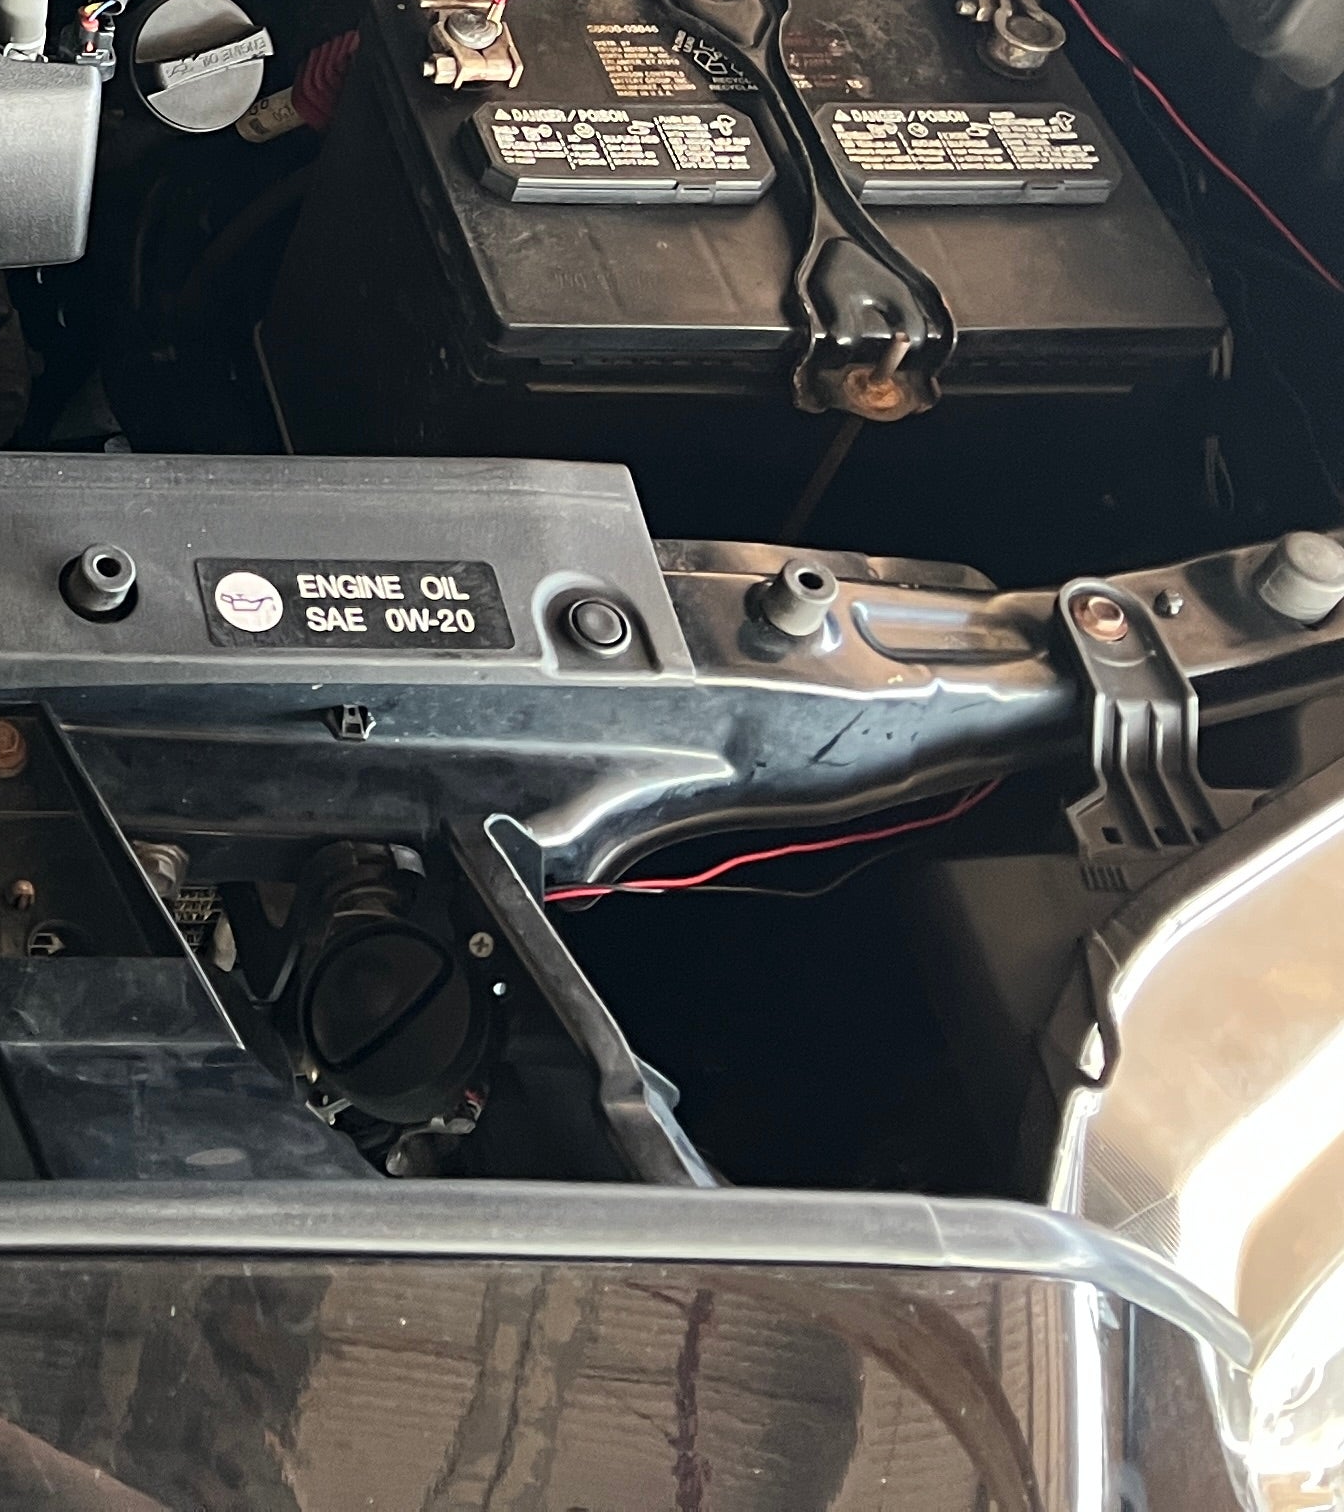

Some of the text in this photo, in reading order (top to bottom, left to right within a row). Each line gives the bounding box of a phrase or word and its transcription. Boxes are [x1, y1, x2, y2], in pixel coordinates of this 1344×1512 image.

[296, 573, 470, 602] ENGINE OIL
[305, 605, 476, 634] SAE 0W-20
